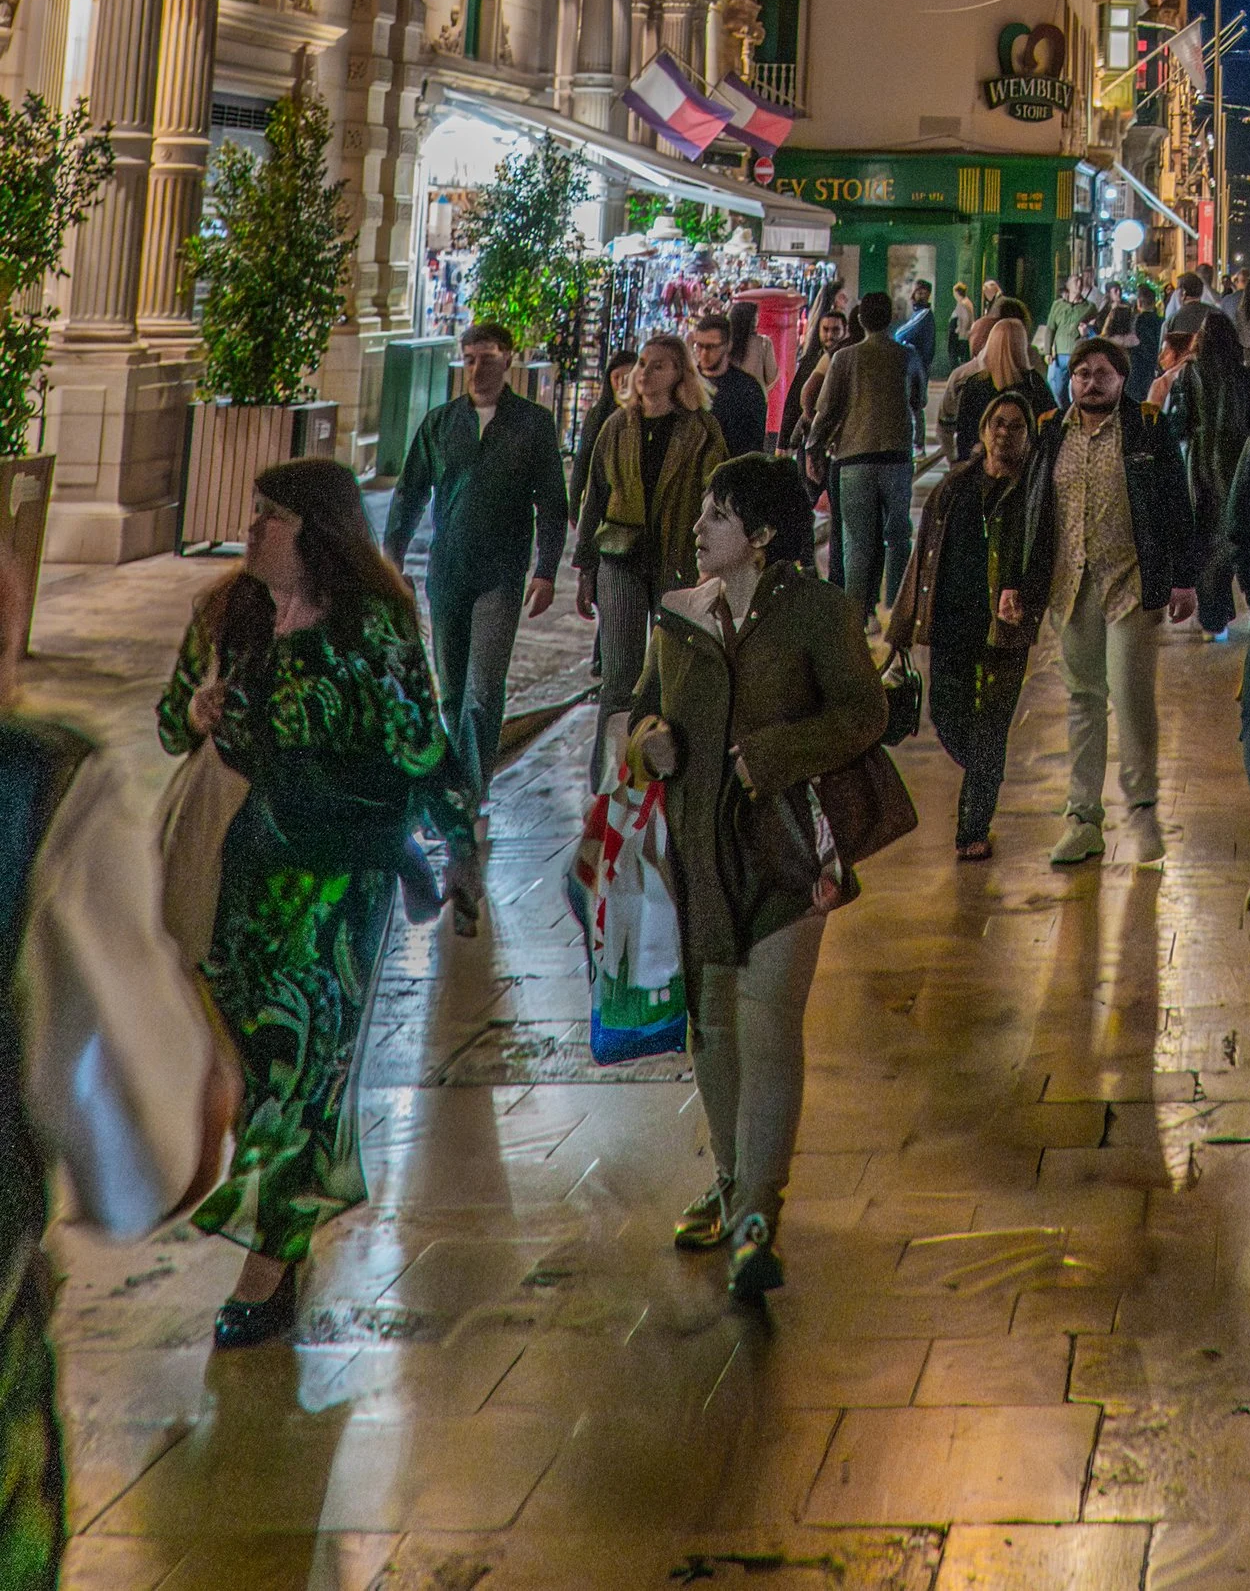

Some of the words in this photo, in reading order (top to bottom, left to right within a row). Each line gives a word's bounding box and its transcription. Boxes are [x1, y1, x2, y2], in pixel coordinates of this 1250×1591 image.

[989, 77, 1072, 109] WEMBLEY
[1015, 104, 1048, 119] STORE
[814, 177, 896, 202] STORE
